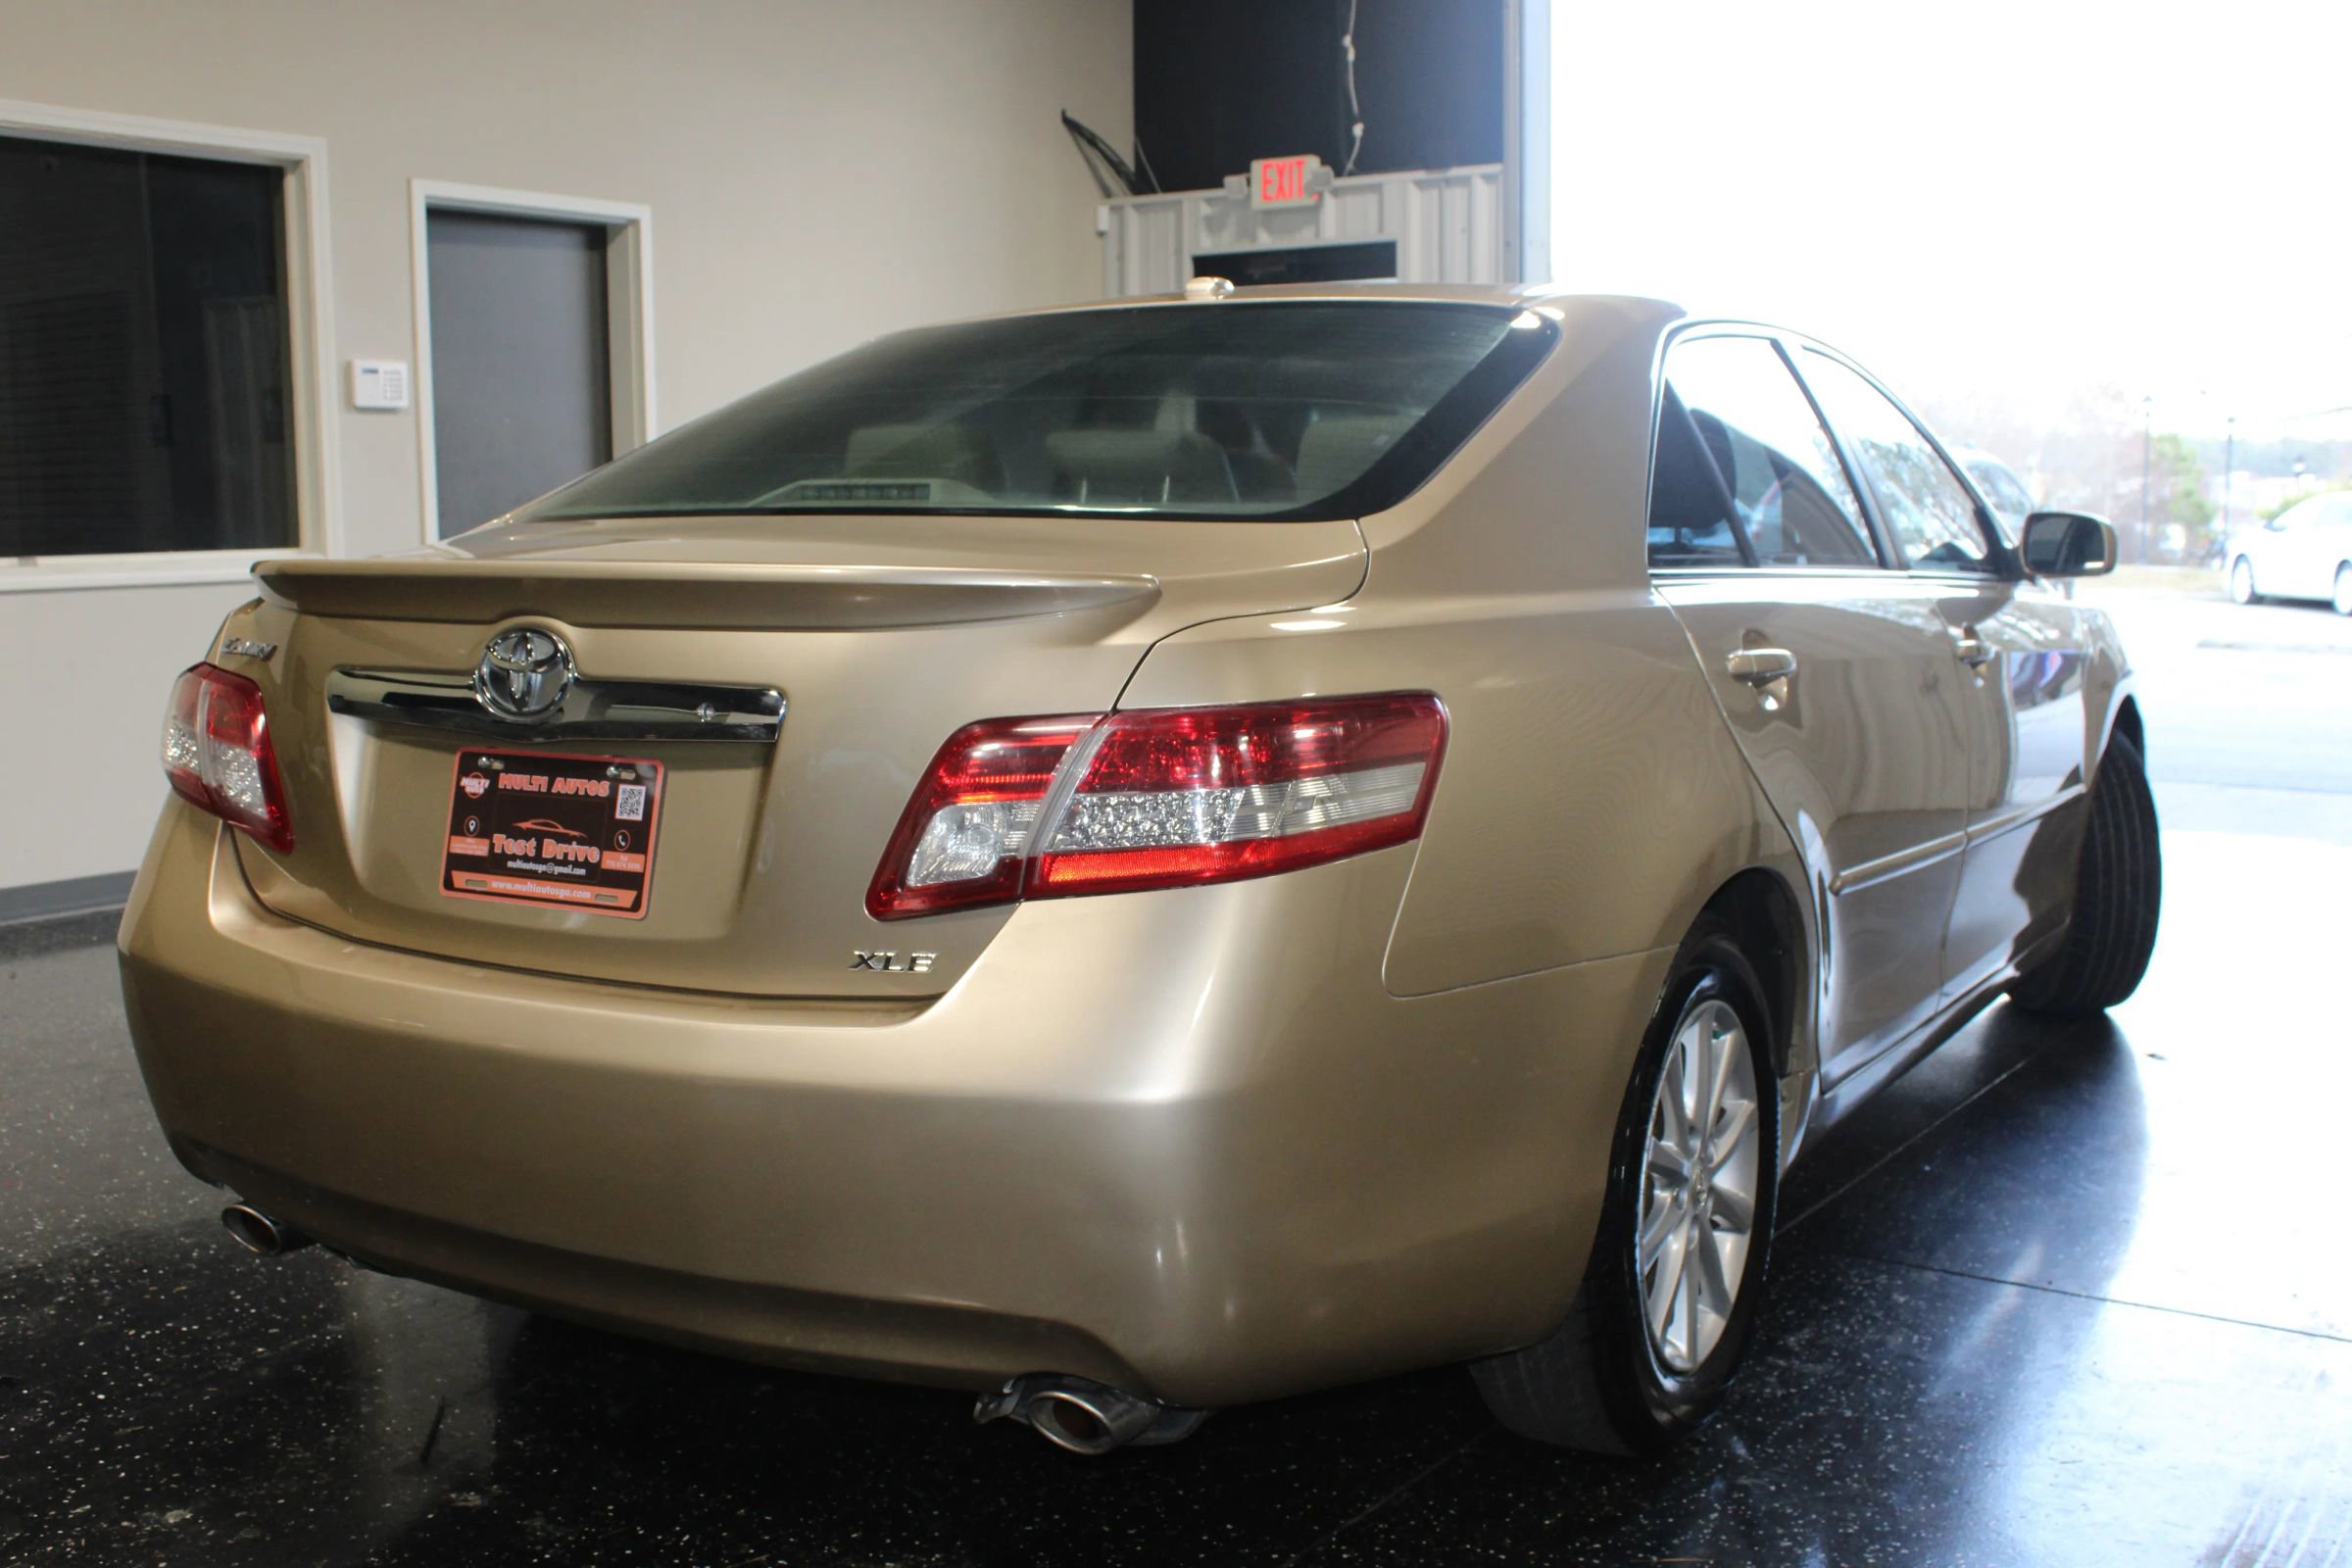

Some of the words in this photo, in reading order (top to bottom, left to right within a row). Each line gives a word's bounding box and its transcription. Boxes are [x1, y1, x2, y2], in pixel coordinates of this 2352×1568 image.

[1261, 159, 1305, 202] EXIT
[498, 772, 548, 790] MULTI
[552, 777, 611, 798] AUTOS
[492, 834, 537, 858] Test
[542, 839, 601, 863] Drive
[848, 951, 937, 973] XLE
